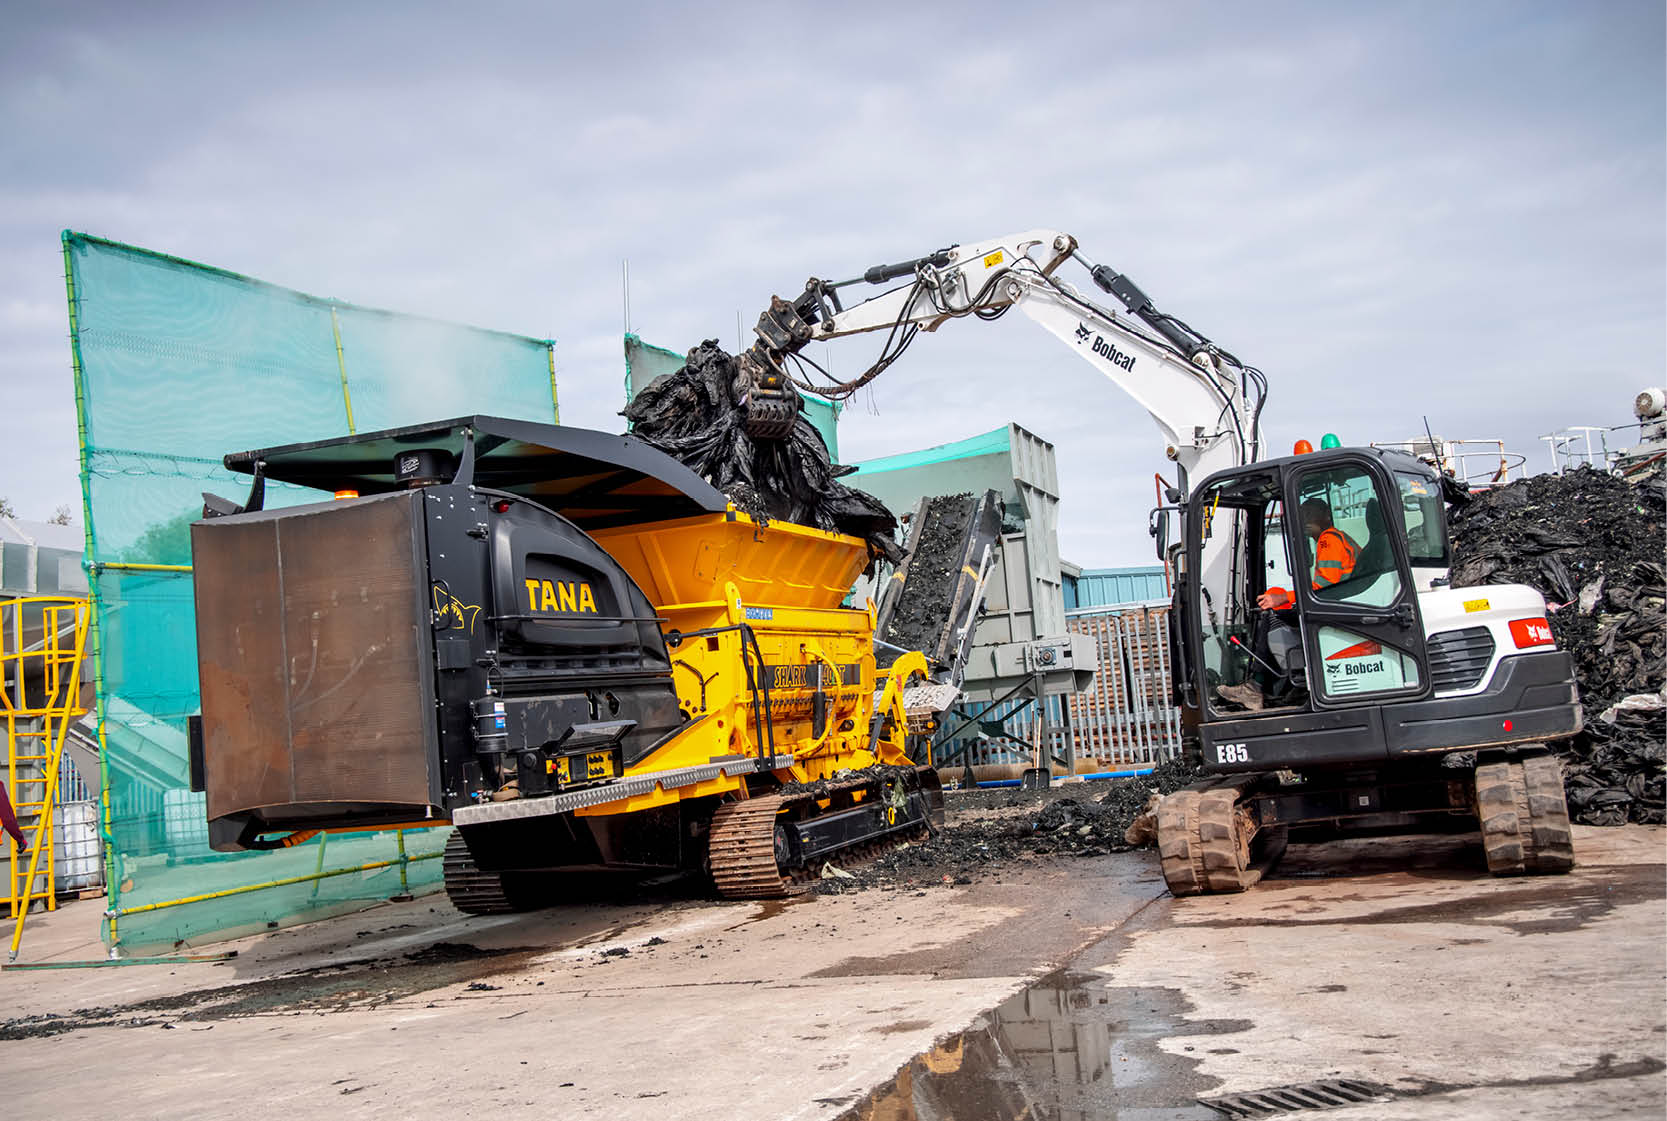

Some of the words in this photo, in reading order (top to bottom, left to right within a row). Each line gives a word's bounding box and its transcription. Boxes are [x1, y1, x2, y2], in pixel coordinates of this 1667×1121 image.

[1092, 335, 1136, 373] Bobcat
[525, 579, 598, 613] TANA
[774, 660, 807, 688] SHARK
[1345, 661, 1384, 676] Bobcat
[1216, 743, 1248, 764] E85
